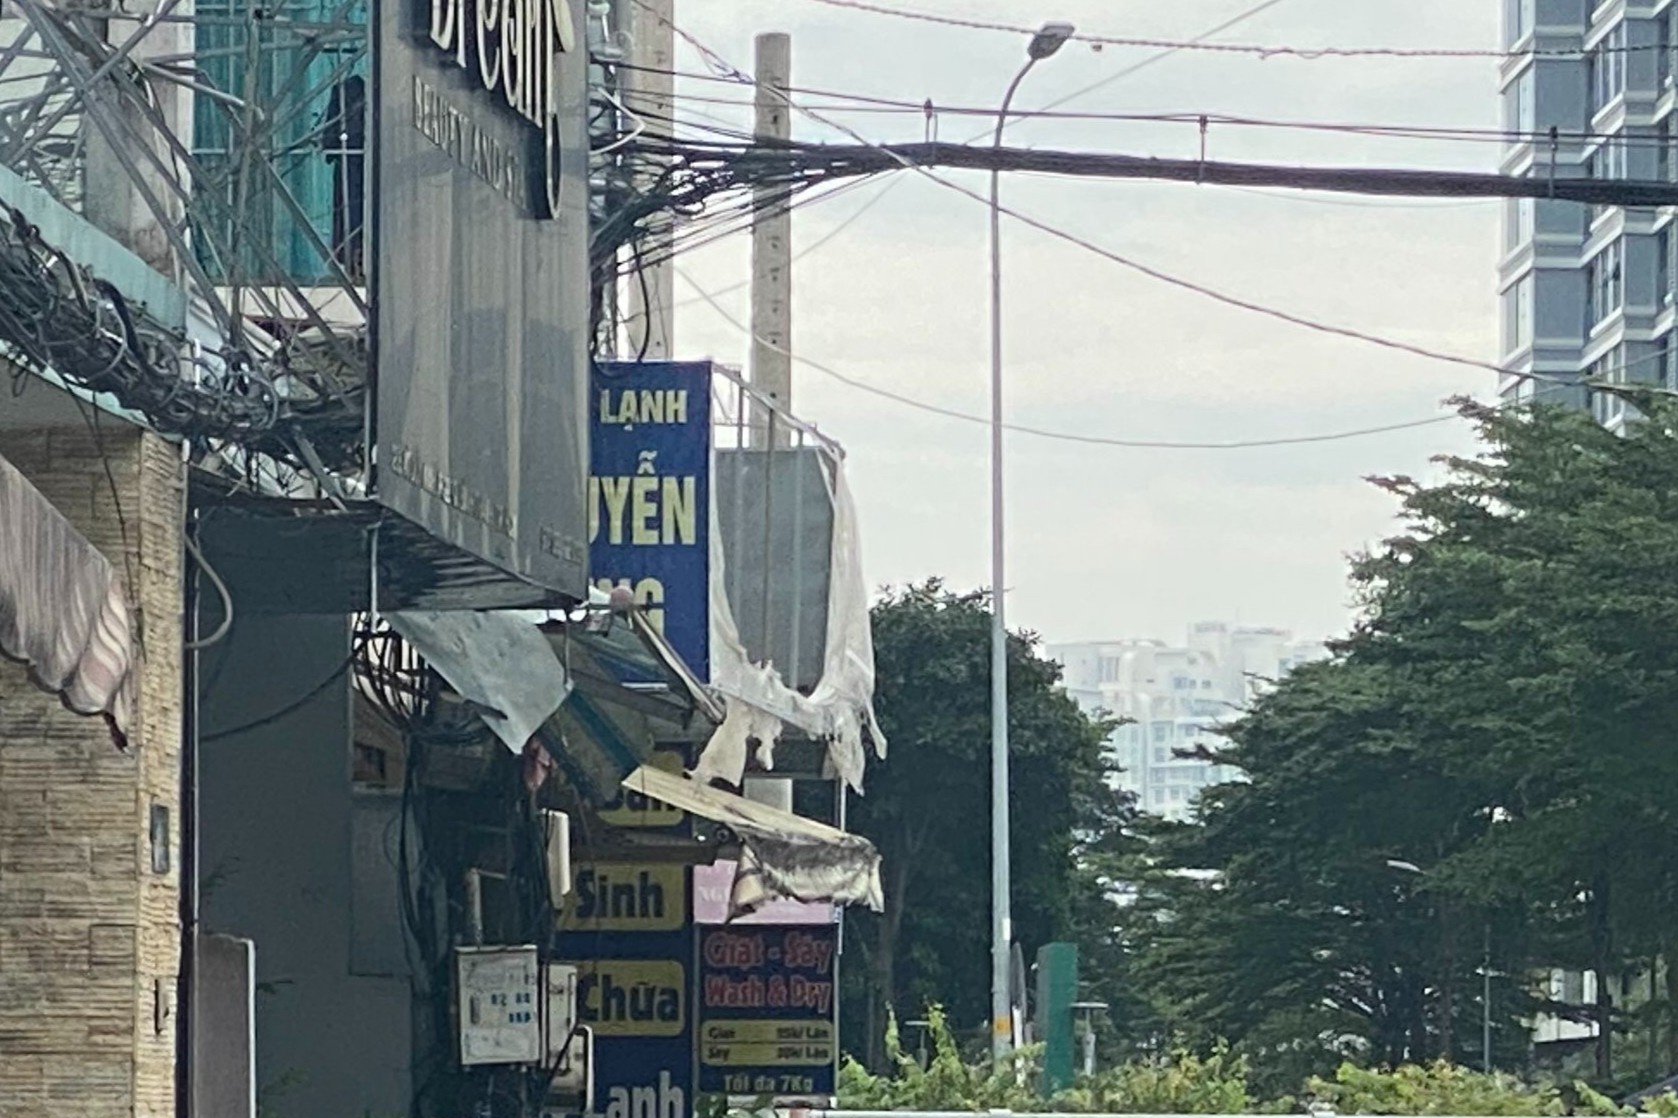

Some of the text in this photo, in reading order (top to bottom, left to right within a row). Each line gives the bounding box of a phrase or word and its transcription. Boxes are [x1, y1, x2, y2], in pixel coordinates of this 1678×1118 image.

[600, 388, 688, 431] LẠNH
[575, 868, 664, 919] Sinh
[577, 973, 680, 1022] Chữa
[704, 974, 765, 1007] Wash
[790, 975, 833, 1014] Dry
